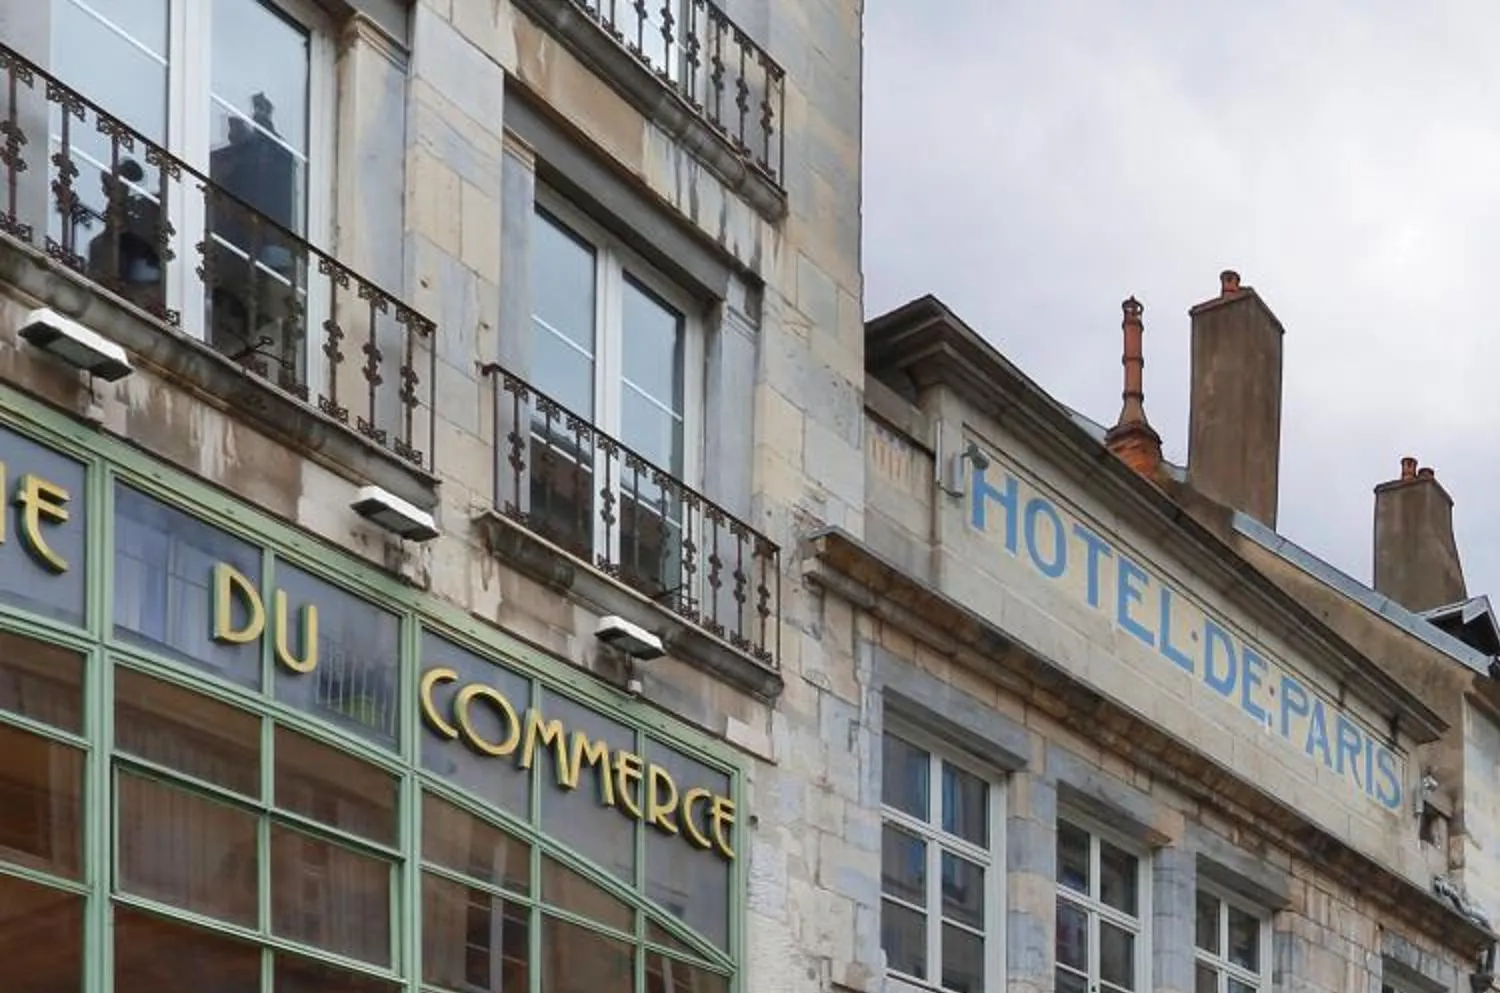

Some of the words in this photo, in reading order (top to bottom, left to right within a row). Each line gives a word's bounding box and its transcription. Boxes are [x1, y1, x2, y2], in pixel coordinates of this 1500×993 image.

[214, 563, 319, 673] DU
[419, 667, 736, 859] COMMERCE
[972, 467, 1194, 675] HOTEL
[1281, 673, 1402, 810] PARIS
